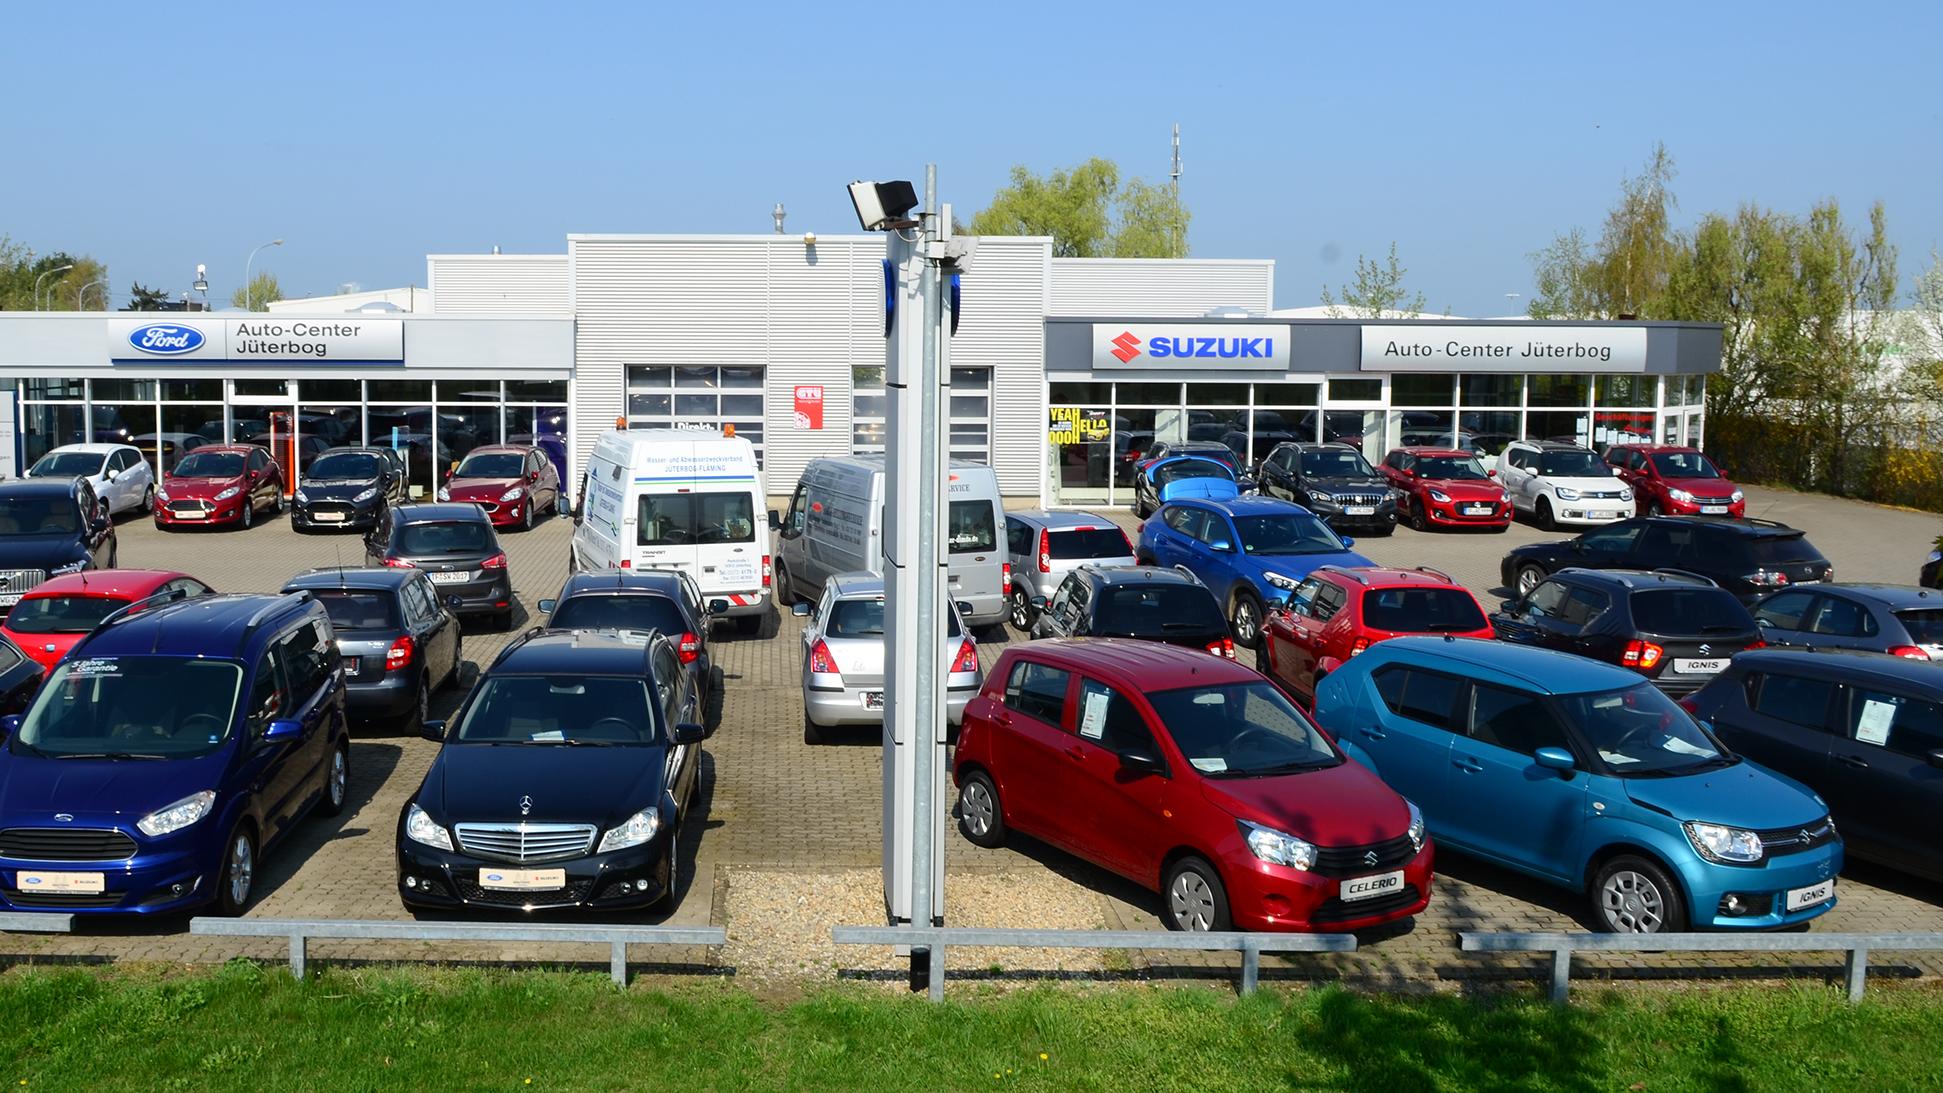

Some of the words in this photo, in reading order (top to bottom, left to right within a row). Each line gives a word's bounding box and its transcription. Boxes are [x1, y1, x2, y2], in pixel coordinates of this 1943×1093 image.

[236, 323, 361, 337] Auto-Center
[140, 328, 190, 349] Ford
[236, 340, 327, 357] Jüterbog
[1148, 337, 1273, 358] SUZUKI
[1521, 342, 1612, 361] Jüterbog
[1688, 661, 1719, 669] IGNIS
[1349, 877, 1397, 893] CELERIO
[1800, 887, 1825, 903] IGNIS
